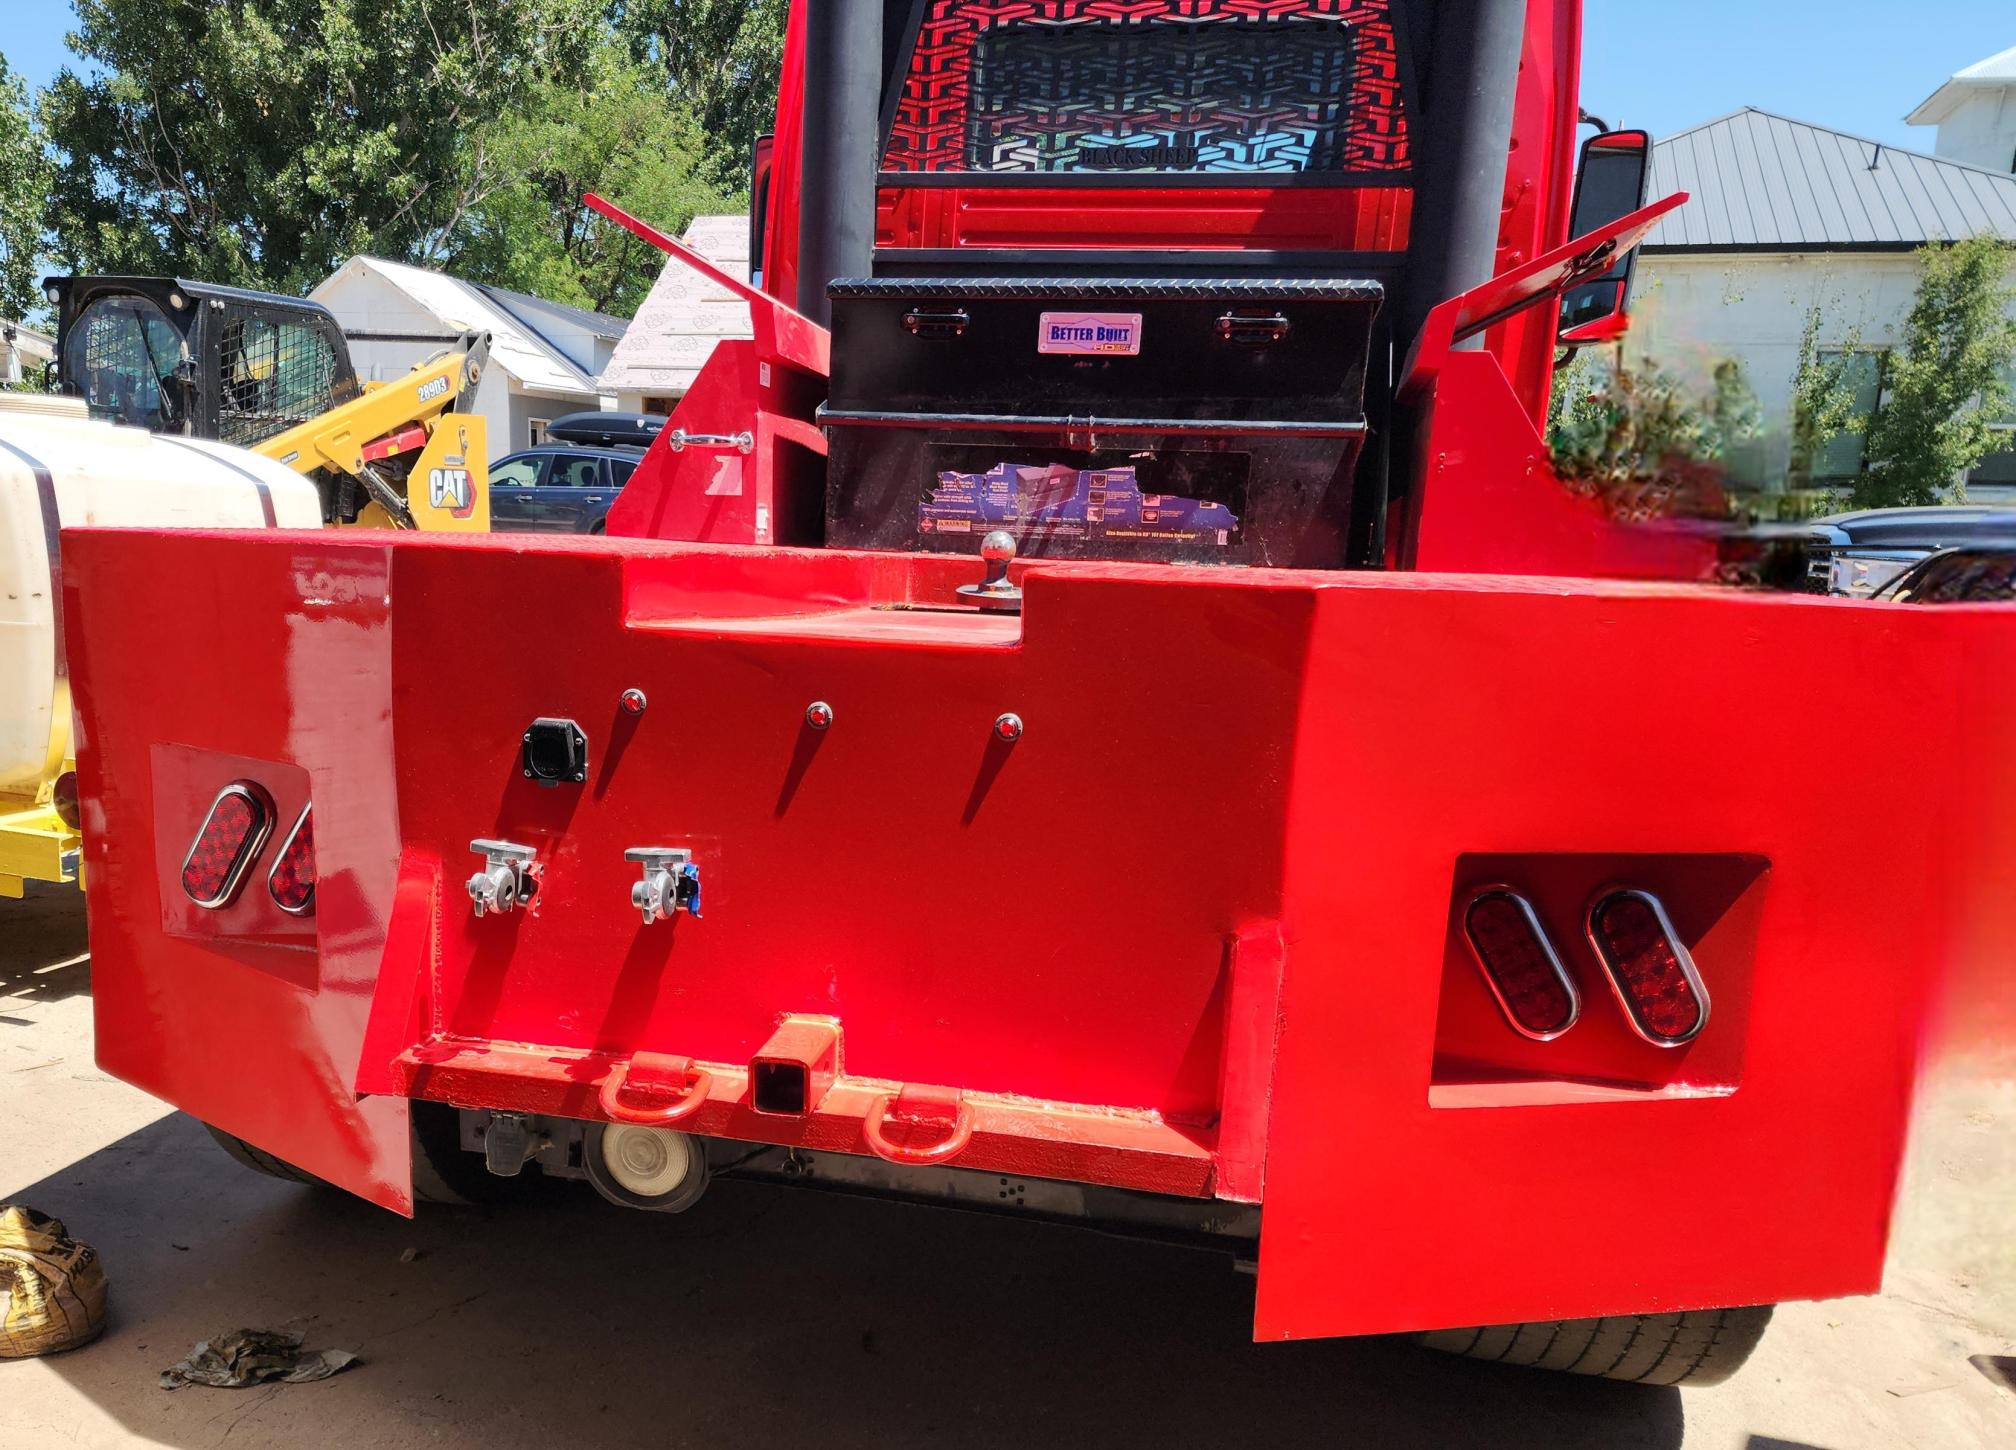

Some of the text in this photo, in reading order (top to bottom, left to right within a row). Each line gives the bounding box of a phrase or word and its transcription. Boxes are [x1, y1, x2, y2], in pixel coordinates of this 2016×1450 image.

[1081, 148, 1197, 165] BLACK SHEEP
[418, 377, 447, 402] 289D3
[430, 469, 466, 508] CAT
